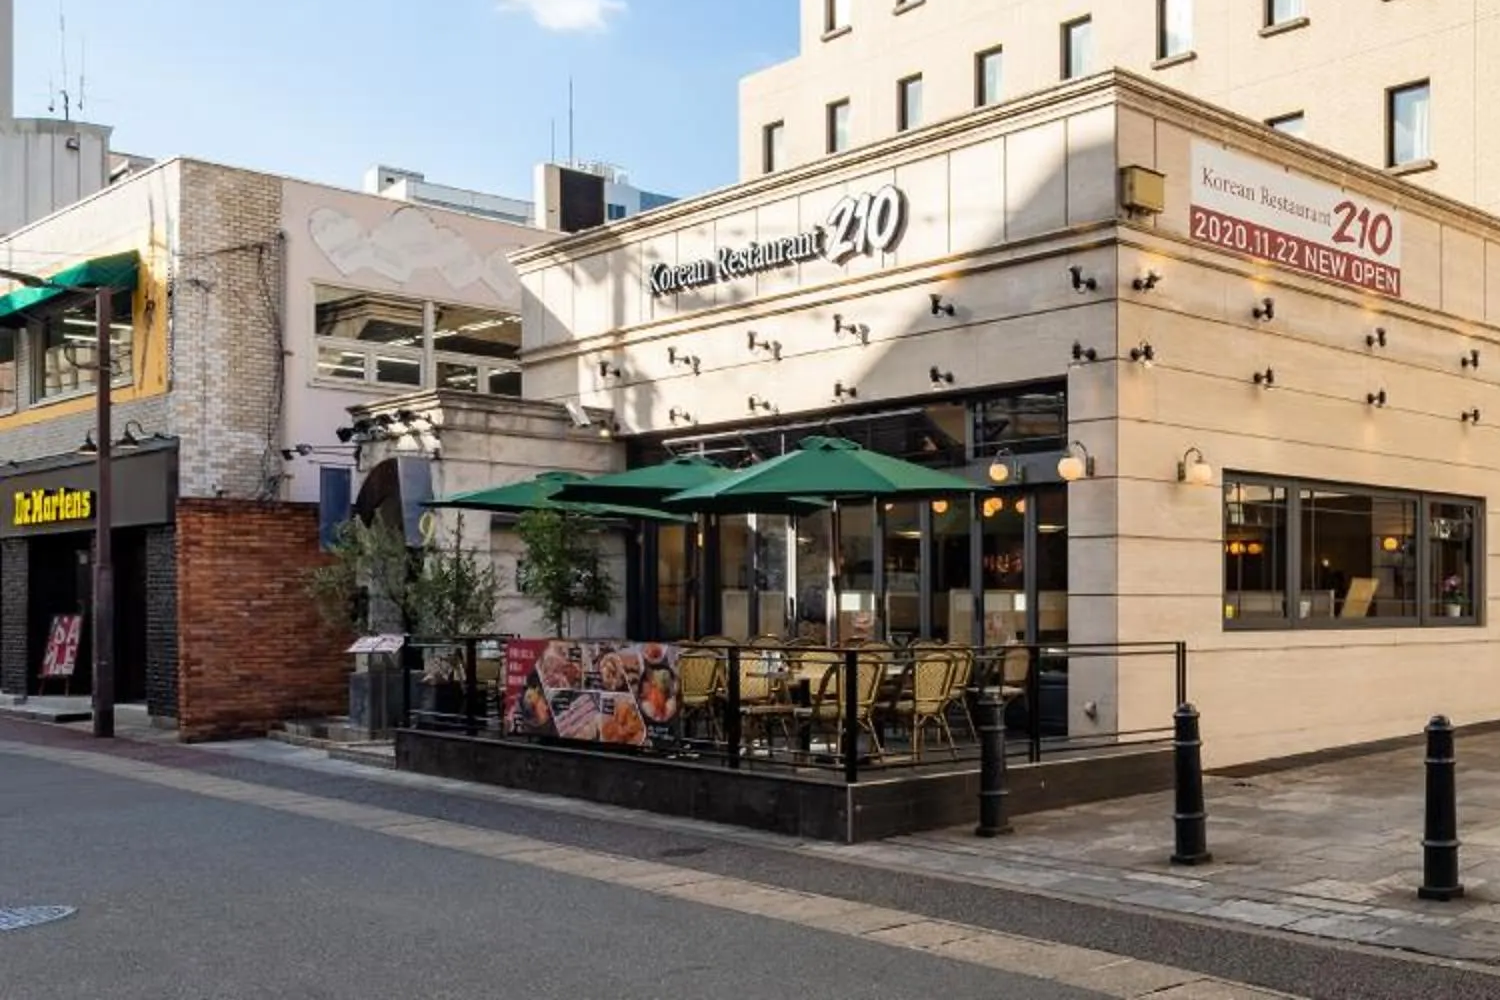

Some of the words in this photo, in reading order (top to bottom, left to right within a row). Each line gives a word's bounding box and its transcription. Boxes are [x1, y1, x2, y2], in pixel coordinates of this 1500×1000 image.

[648, 259, 712, 295] Korean
[715, 227, 829, 280] Restaurant
[826, 184, 905, 264] 210
[1195, 211, 1299, 265] 2020.11.22
[1304, 246, 1347, 279] NEW
[1351, 260, 1398, 294] OPEN
[1201, 167, 1255, 201] Korean
[1261, 185, 1331, 228] Restaurant
[1331, 200, 1393, 256] 210
